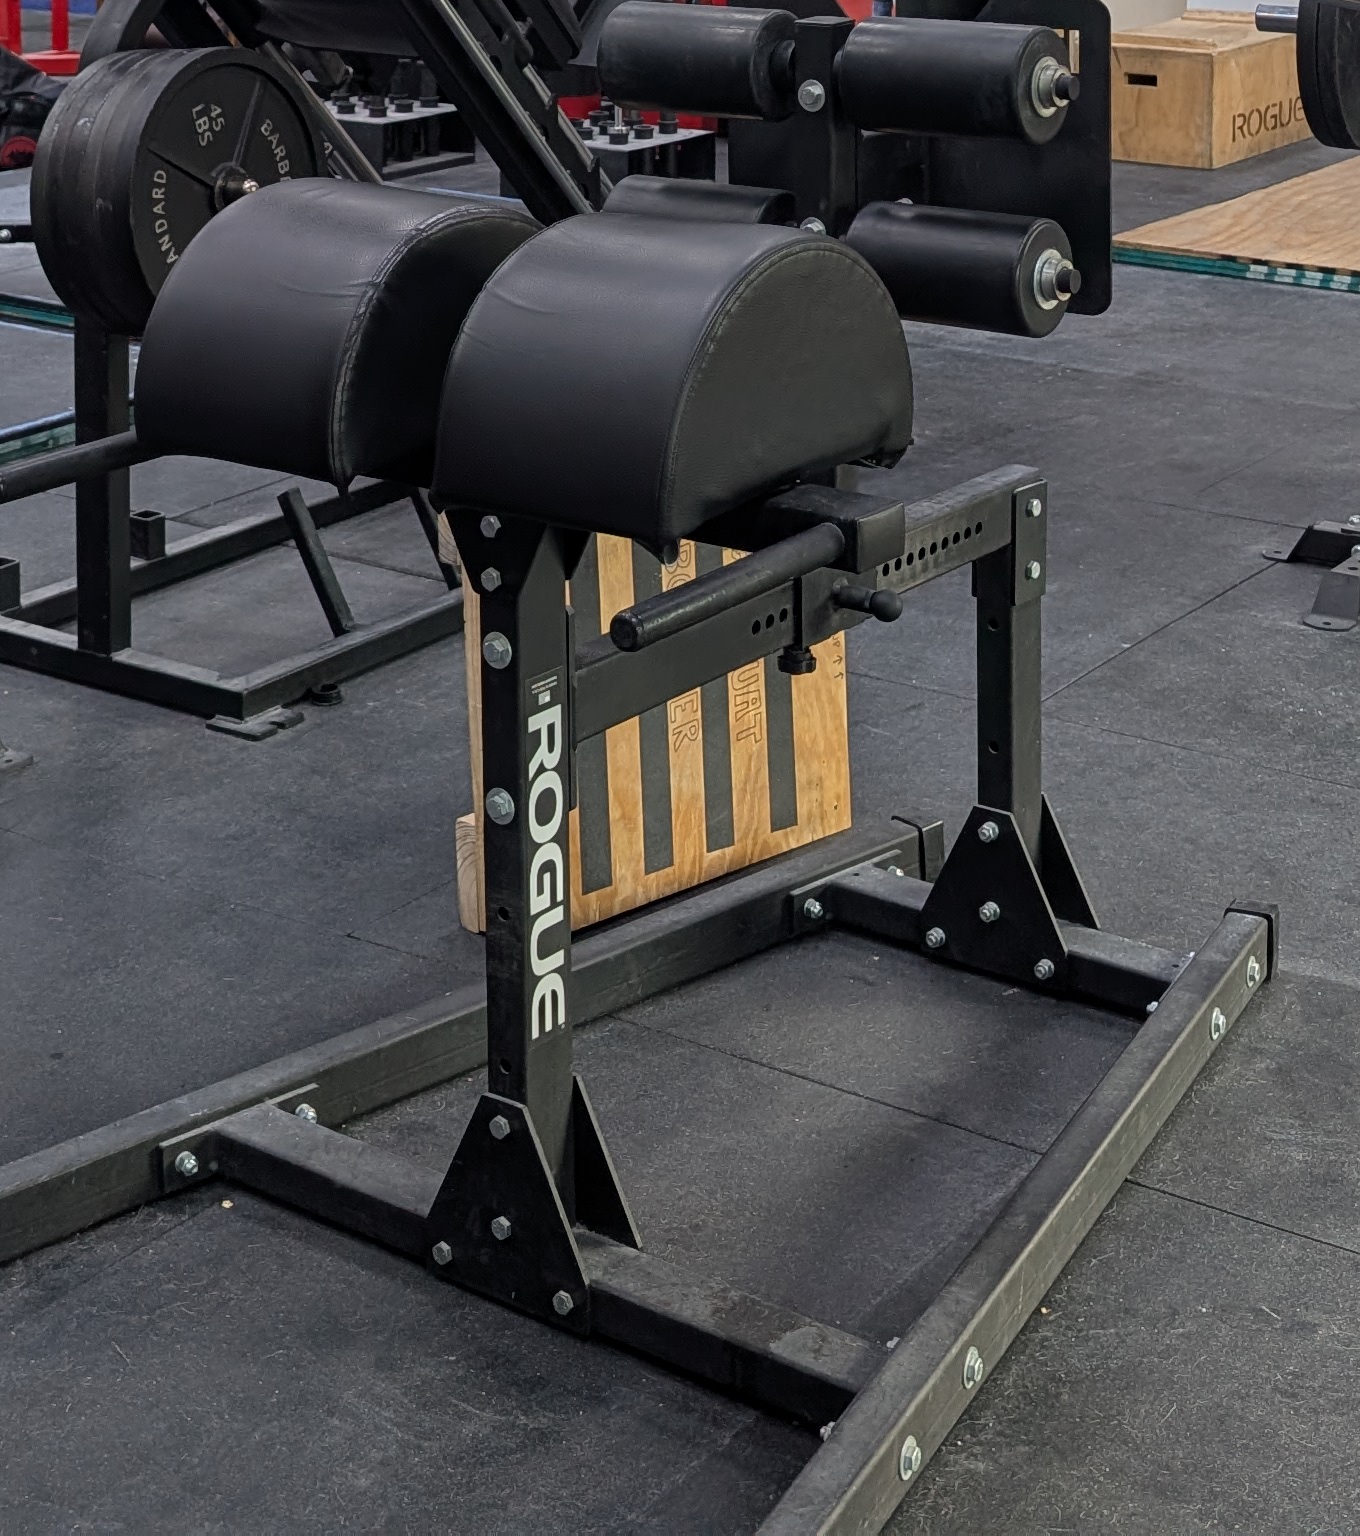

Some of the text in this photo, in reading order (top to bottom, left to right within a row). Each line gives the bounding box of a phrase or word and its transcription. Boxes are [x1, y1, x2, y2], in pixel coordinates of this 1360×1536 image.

[192, 103, 214, 147] LBS
[210, 103, 225, 132] 45
[1231, 95, 1305, 143] ROGUE
[152, 169, 179, 265] ANDARD
[526, 703, 566, 1041] ROGUE
